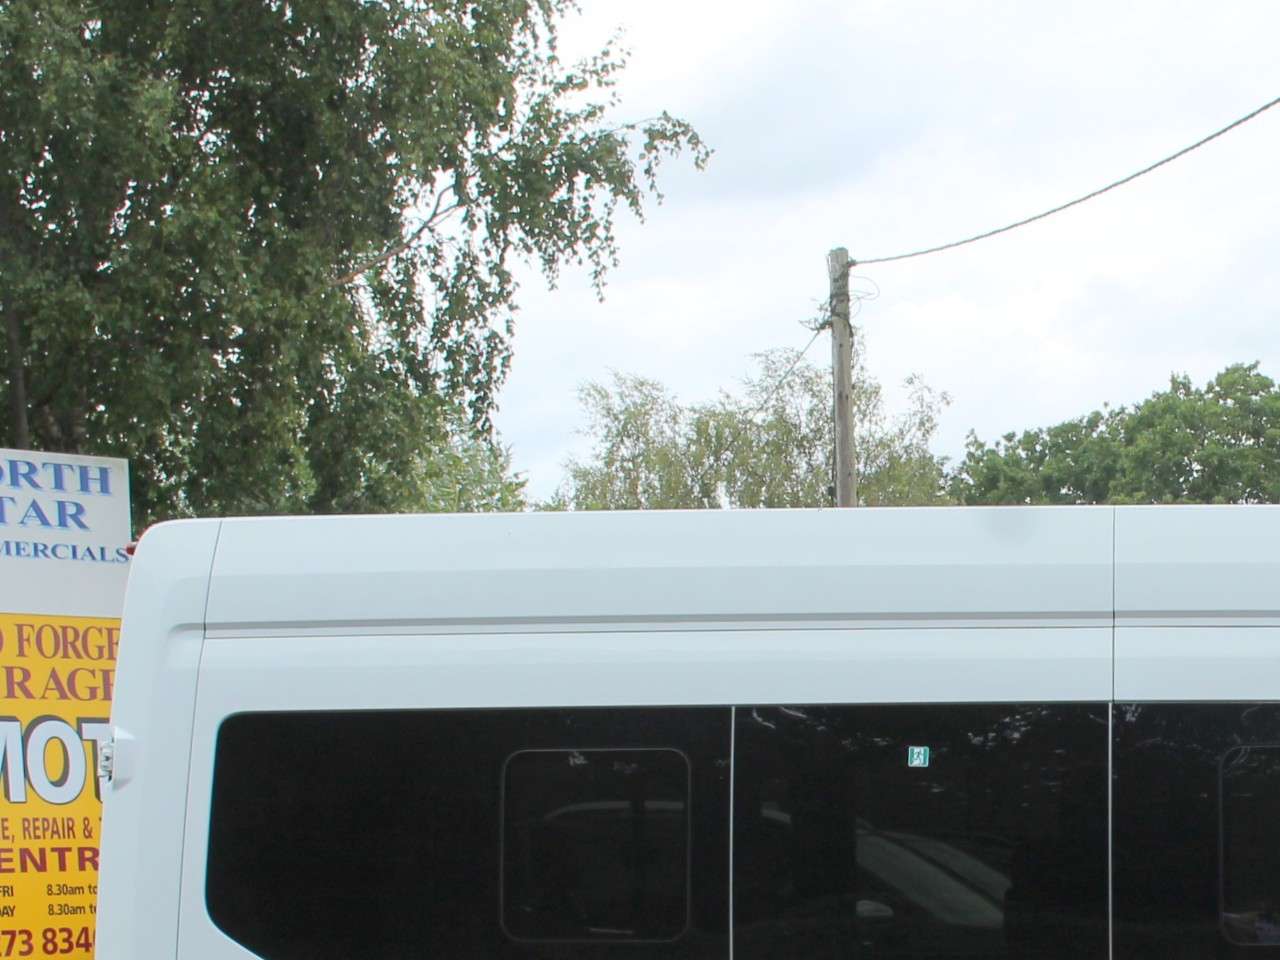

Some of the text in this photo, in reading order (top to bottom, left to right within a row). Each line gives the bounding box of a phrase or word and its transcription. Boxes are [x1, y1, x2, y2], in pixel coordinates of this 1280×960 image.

[0, 459, 111, 495] RTH
[22, 817, 76, 840] REPAIR
[82, 816, 94, 839] &
[46, 883, 85, 896] 8.30am
[47, 903, 86, 916] 8.30am
[0, 926, 96, 957] 73 834
